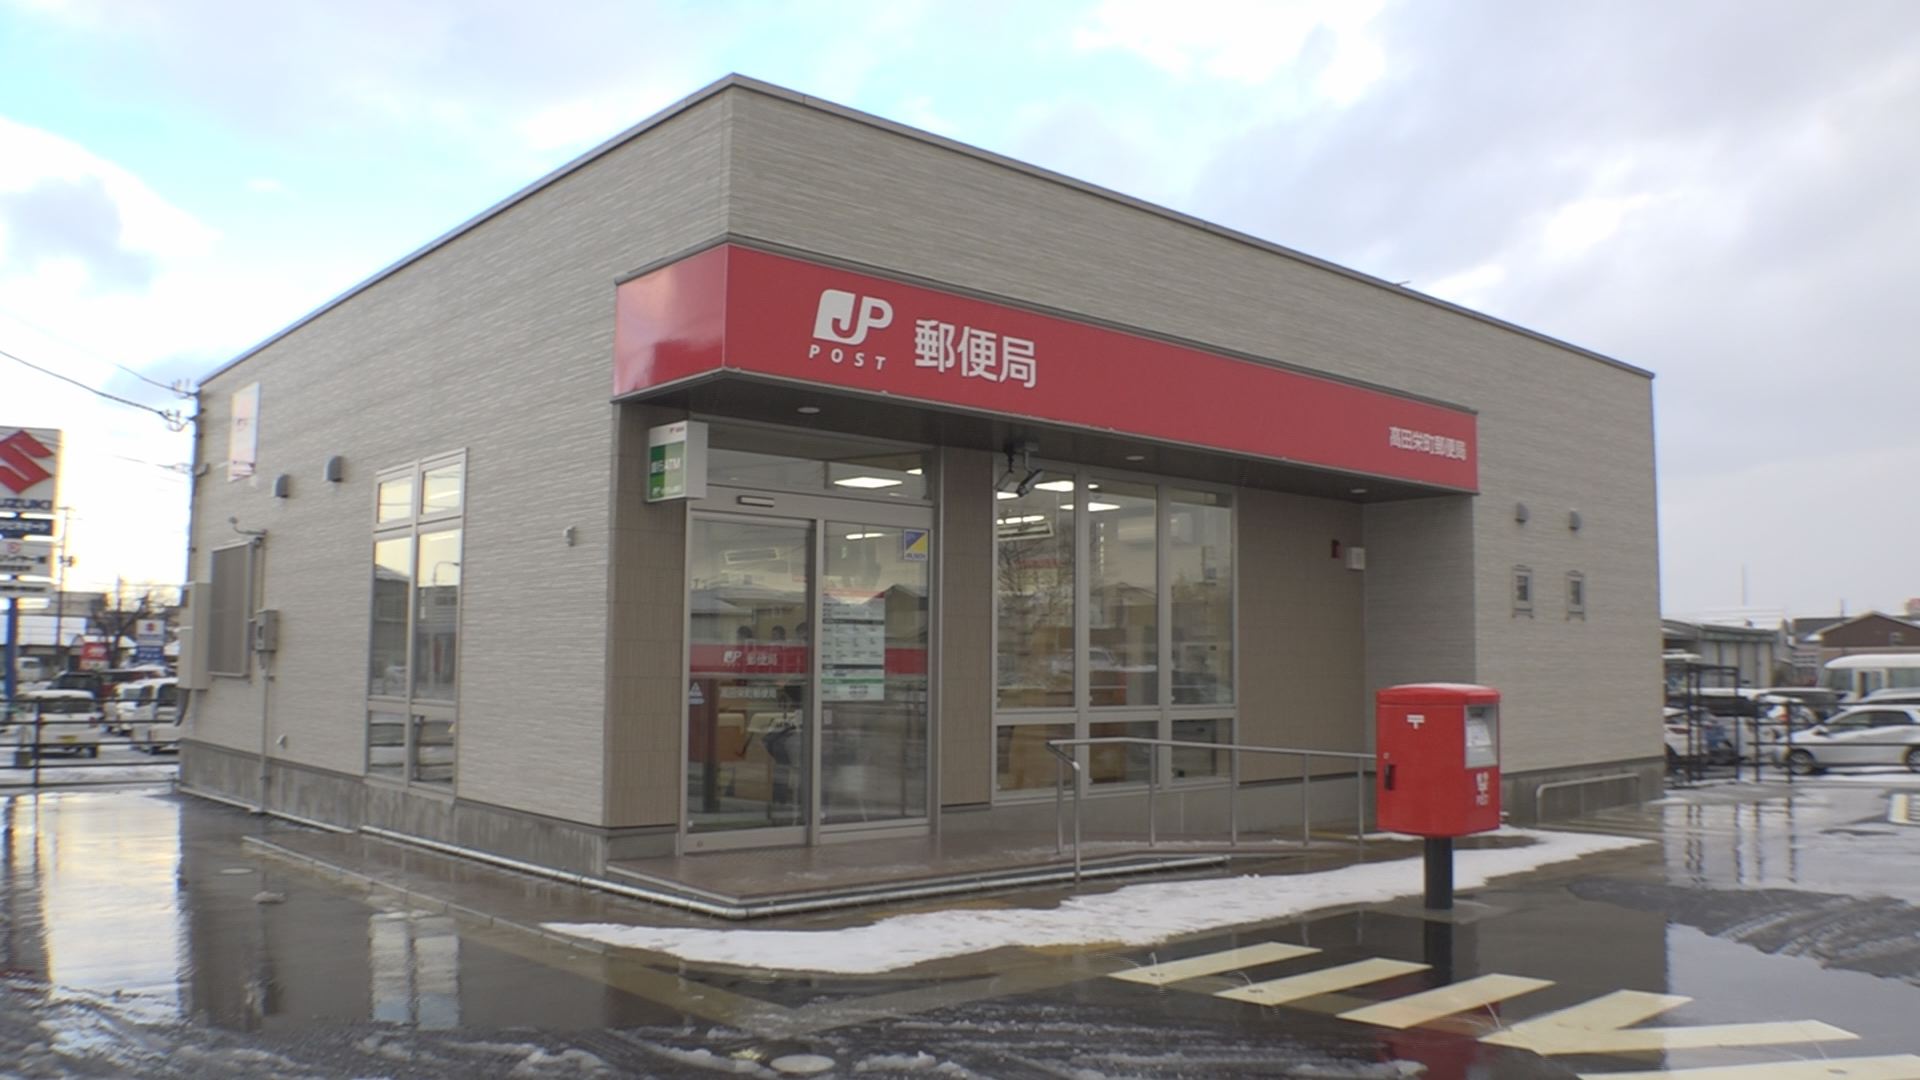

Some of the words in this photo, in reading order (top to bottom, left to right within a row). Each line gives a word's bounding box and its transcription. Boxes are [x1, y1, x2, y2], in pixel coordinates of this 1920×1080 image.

[808, 344, 887, 371] POST
[914, 318, 1037, 389] 郵便局
